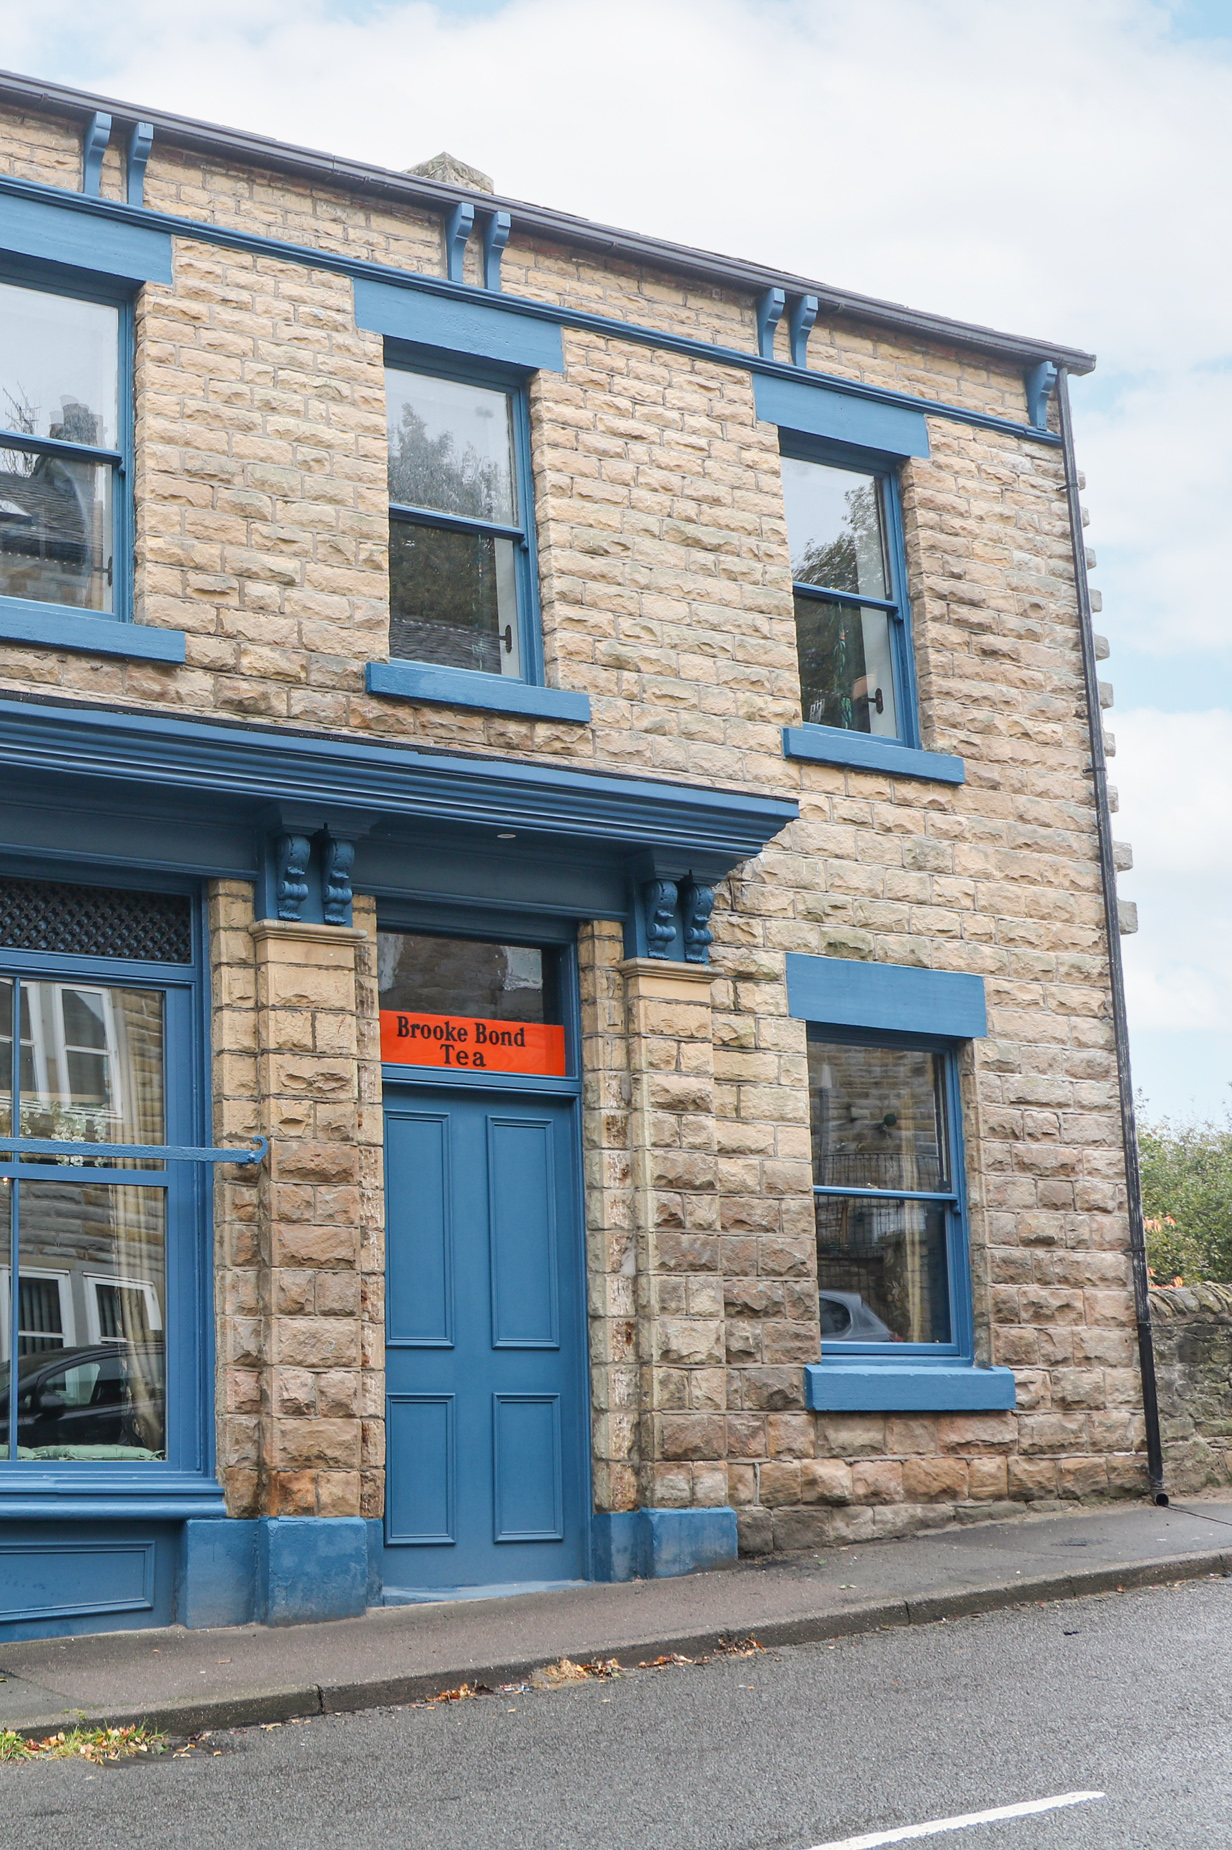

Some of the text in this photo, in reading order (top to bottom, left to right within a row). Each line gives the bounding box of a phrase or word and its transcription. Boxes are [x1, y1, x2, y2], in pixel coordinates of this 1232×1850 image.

[397, 1015, 526, 1047] Brooke Bond
[440, 1044, 487, 1067] Tea
